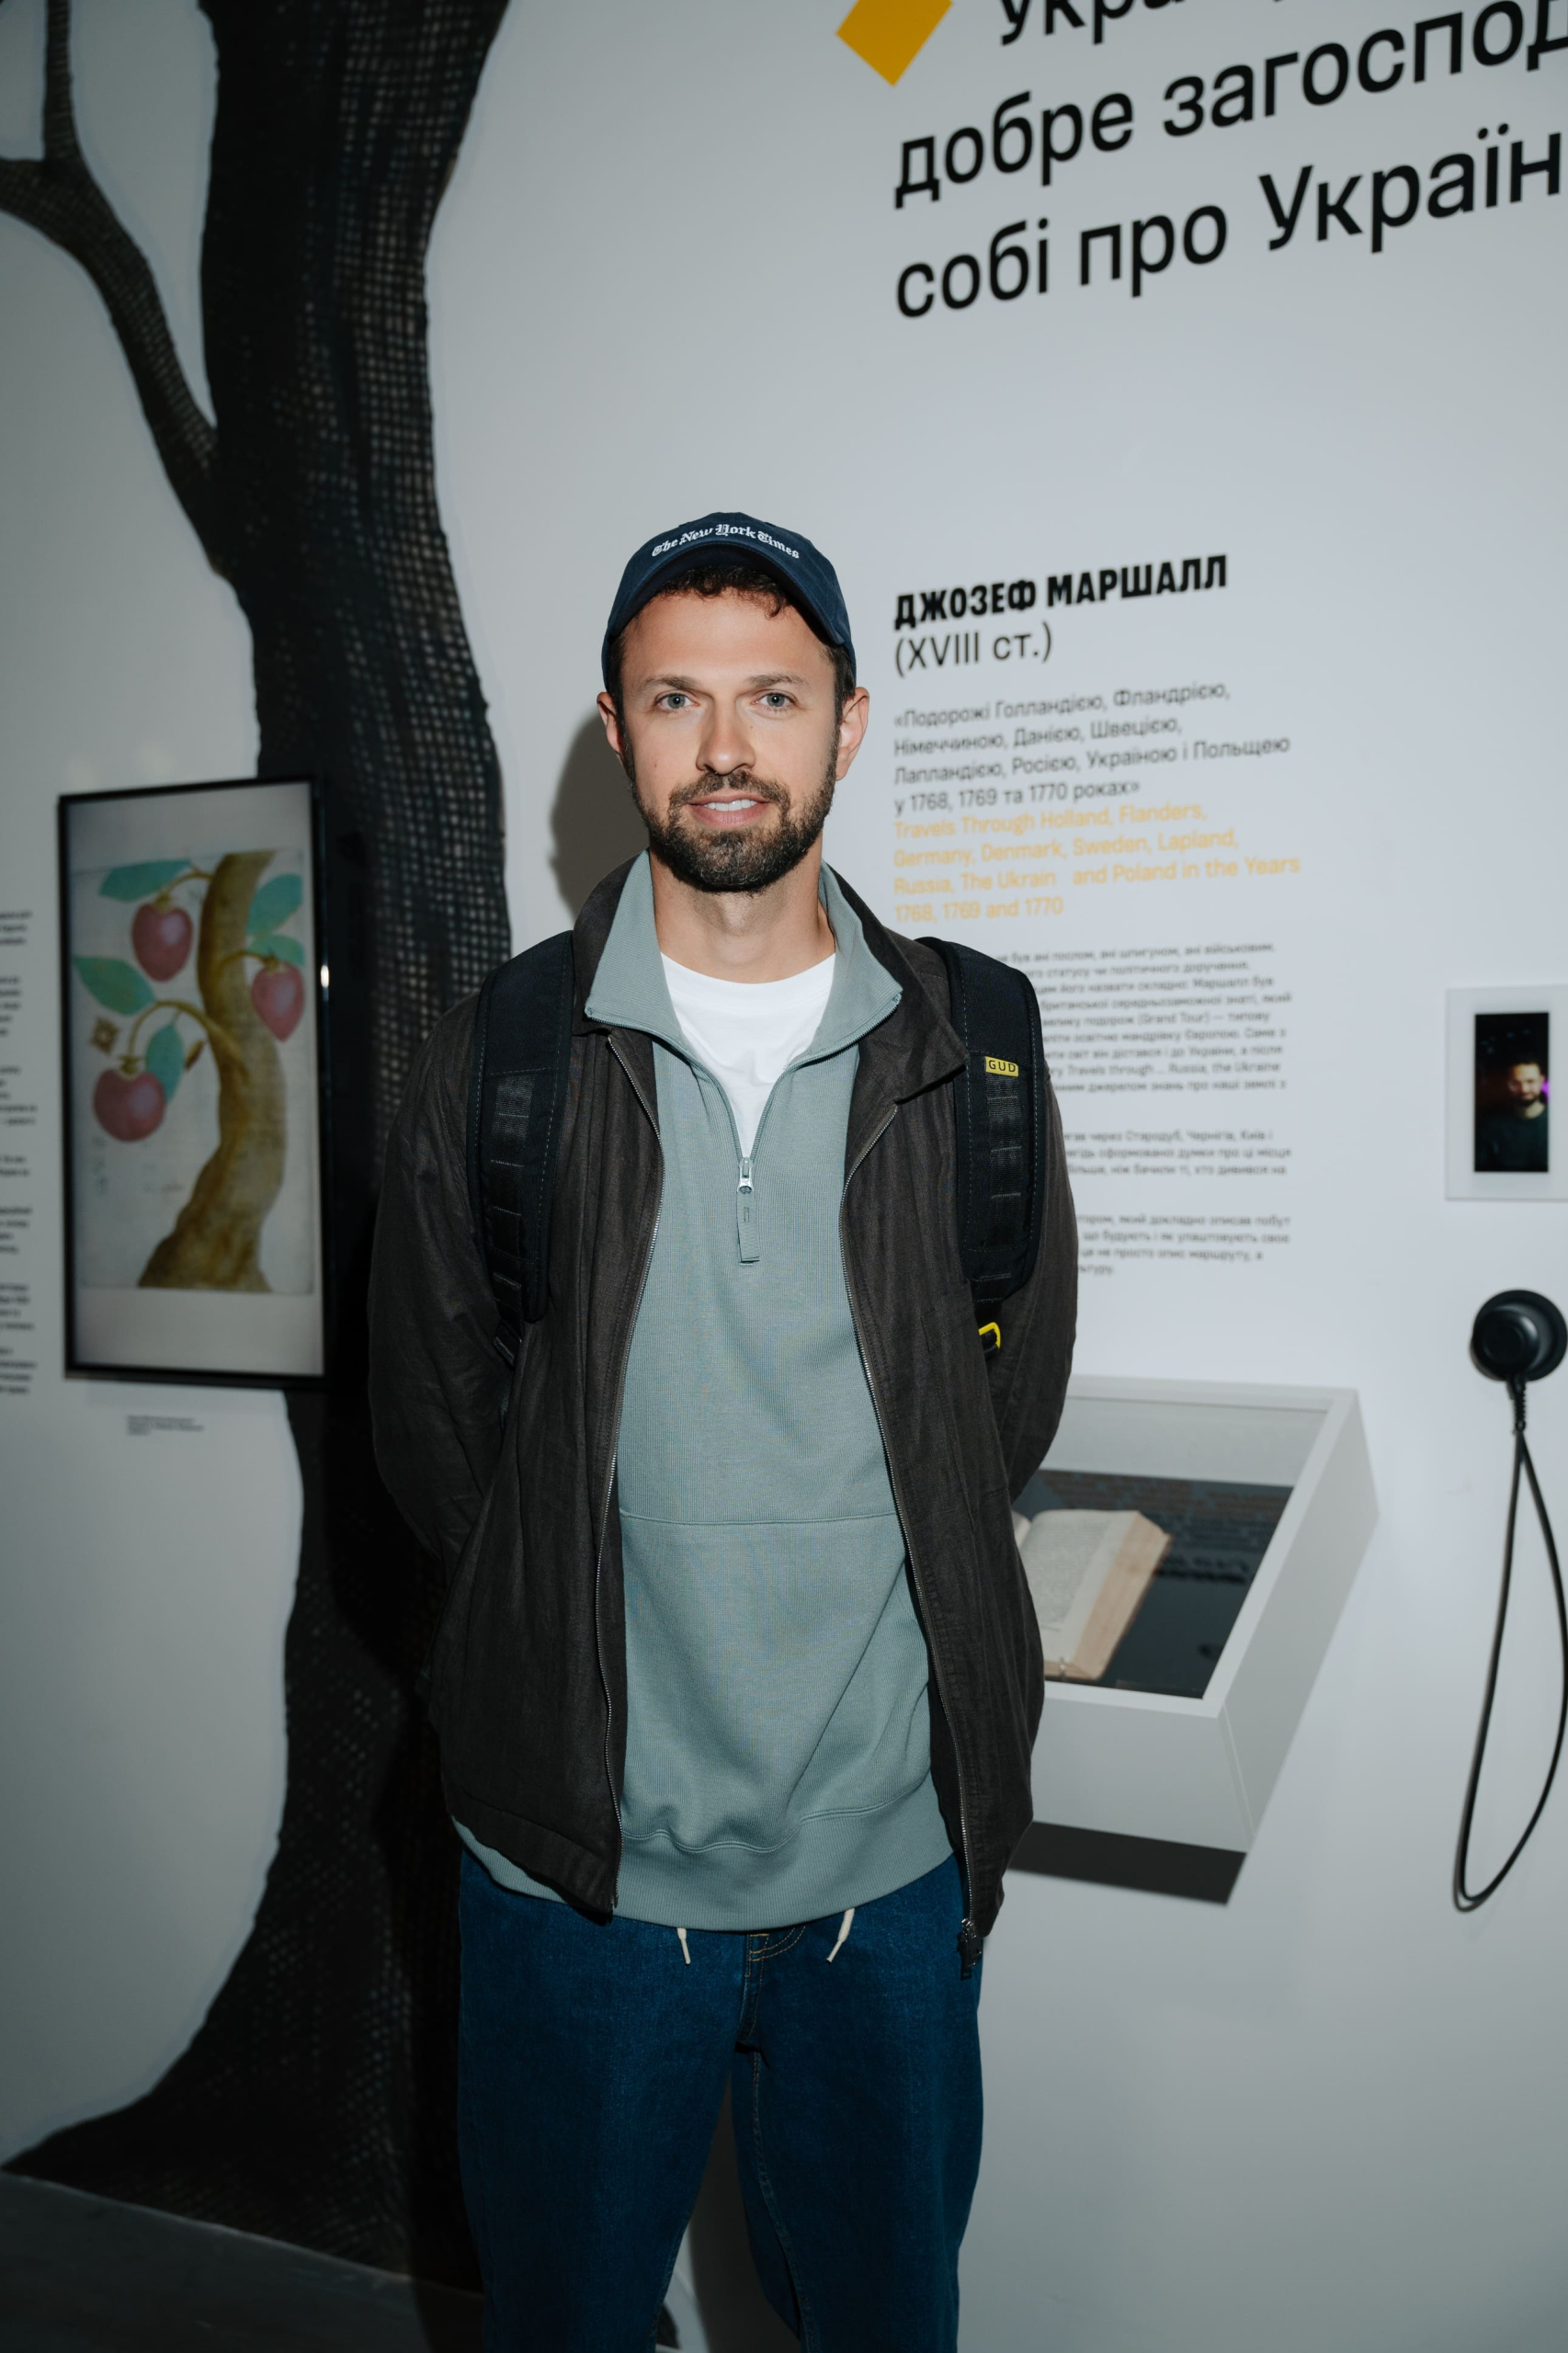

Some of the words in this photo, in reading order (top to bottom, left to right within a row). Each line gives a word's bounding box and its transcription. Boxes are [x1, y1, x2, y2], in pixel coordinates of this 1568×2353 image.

[894, 91, 1134, 210] добре
[895, 218, 1050, 318] собі
[1079, 204, 1228, 298] про
[1258, 122, 1562, 254] Україн
[652, 540, 678, 557] The
[679, 528, 714, 545] New
[715, 524, 756, 540] York
[757, 530, 800, 559] Times
[894, 579, 1037, 631] ДЖОЗЕФ
[1047, 554, 1227, 607] МАРШАЛЛ
[895, 632, 979, 678] (XVIII
[993, 621, 1051, 662] ст.)
[892, 703, 991, 728] «Подорожі
[994, 694, 1107, 718] Голландією,
[1112, 683, 1229, 706] Фландрією,
[892, 733, 1007, 756] Німеччиною,
[1012, 726, 1084, 748] Данією,
[1089, 717, 1181, 739] Швецією,
[892, 761, 1006, 785] Лапландією,
[1010, 755, 1080, 774] Росією,
[1086, 746, 1177, 771] Україною
[1182, 744, 1188, 759] і
[1192, 736, 1290, 758] Польщею
[893, 799, 905, 817] у
[909, 790, 953, 812] 1768,
[958, 787, 998, 807] 1769
[1003, 789, 1024, 803] та
[1029, 780, 1068, 801] 1770
[1072, 781, 1140, 803] роках»
[989, 1060, 1016, 1073] GUD
